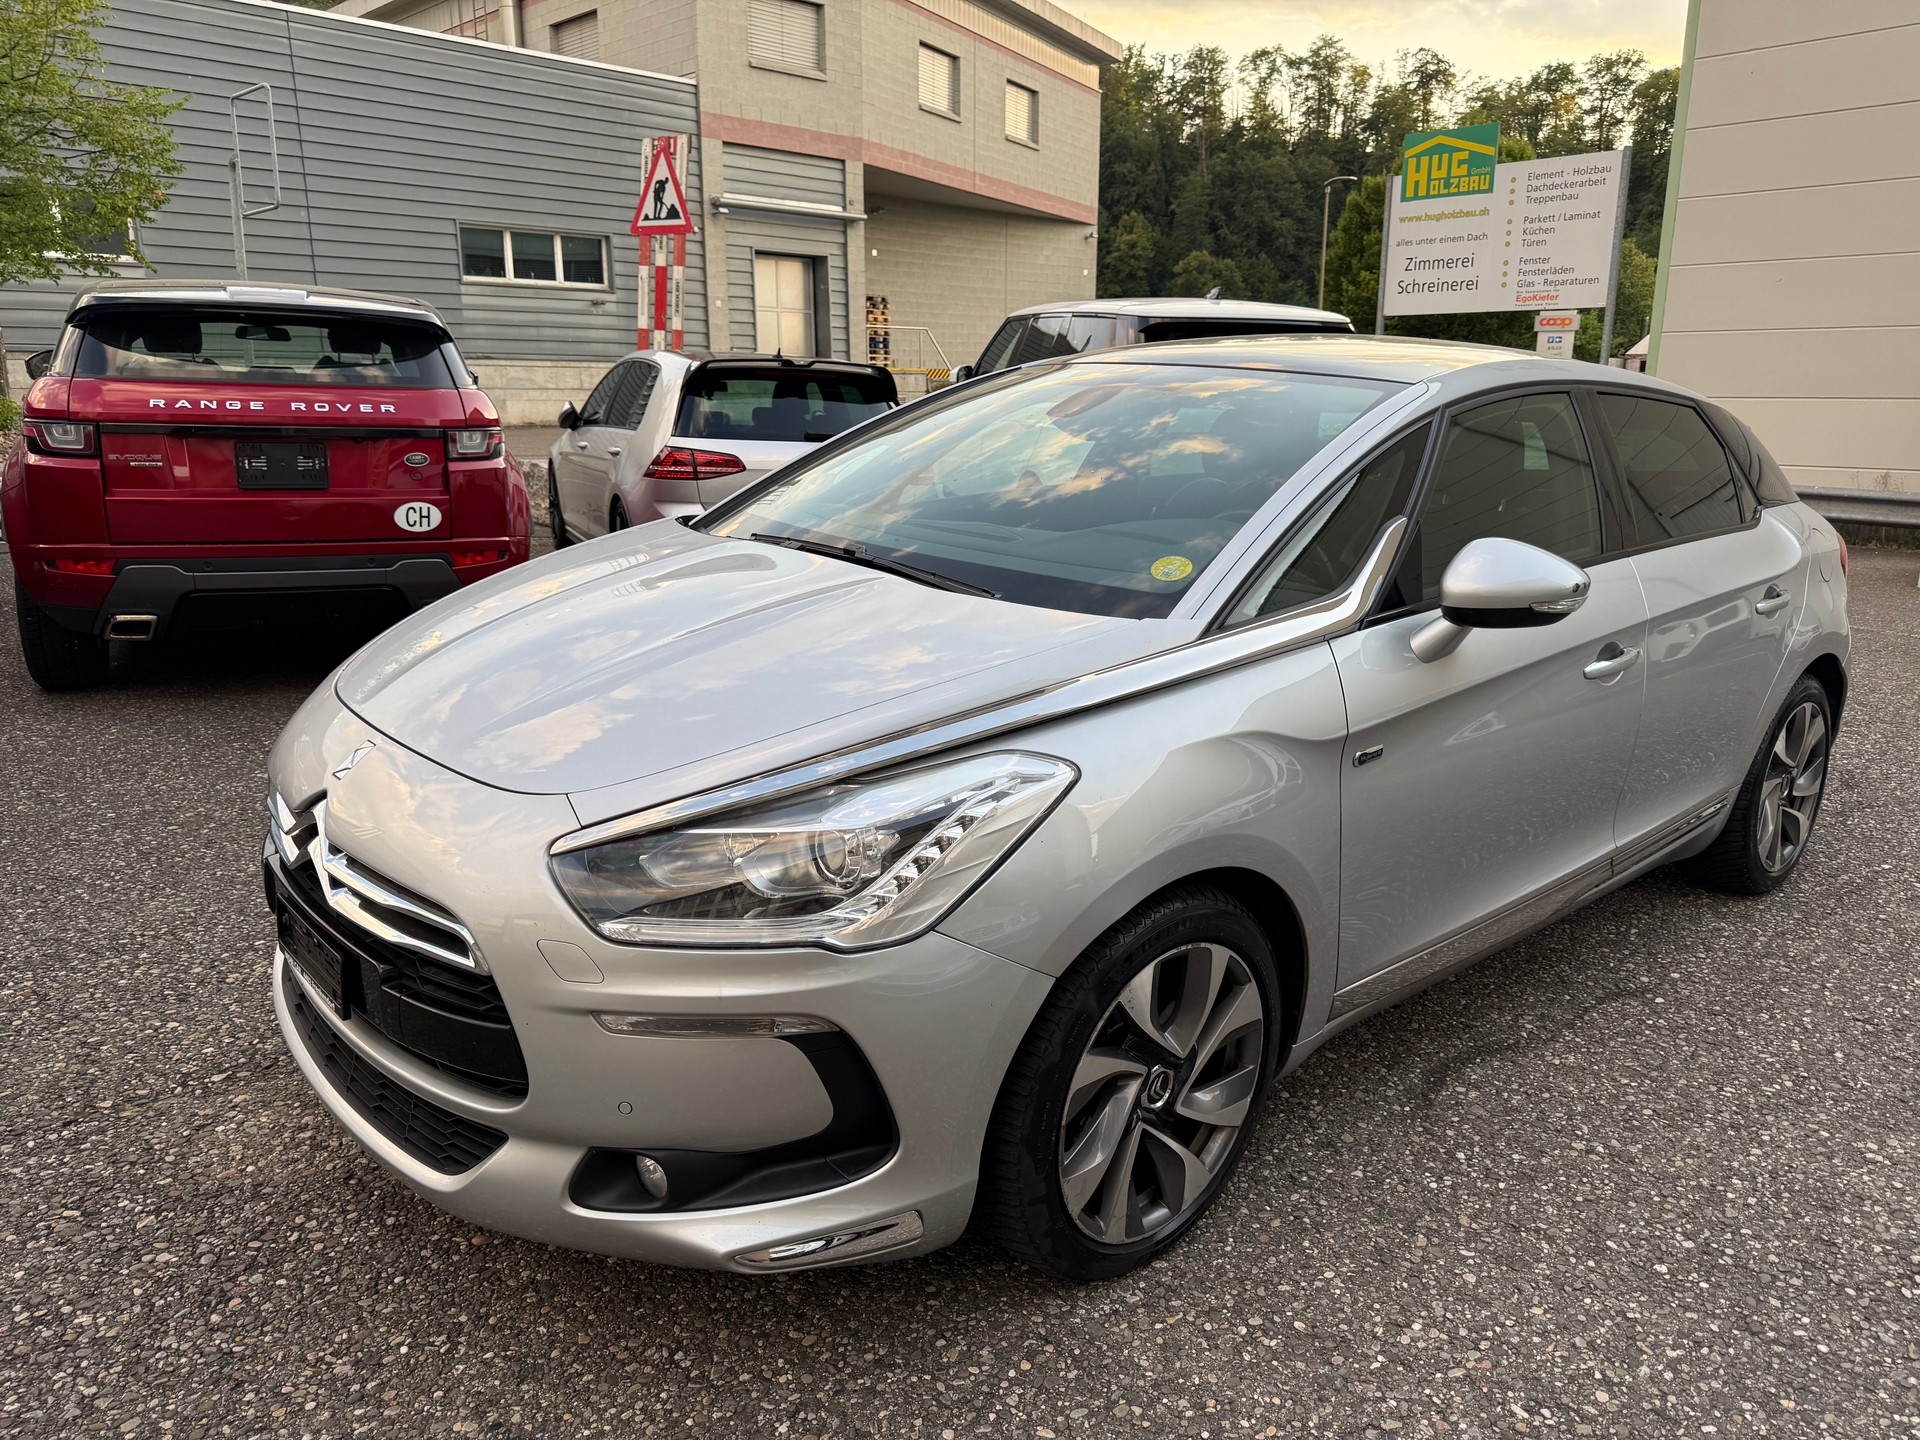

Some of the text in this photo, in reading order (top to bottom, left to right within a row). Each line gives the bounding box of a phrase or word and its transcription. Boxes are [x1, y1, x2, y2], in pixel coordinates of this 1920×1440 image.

[1406, 150, 1491, 198] HUG GmbH
[1527, 170, 1564, 181] Element
[1572, 165, 1612, 177] Holzbau
[1526, 176, 1606, 193] Dachdeckerarbeit
[1526, 192, 1579, 205] Treppenbau
[1399, 207, 1490, 224] www.hugholzbau.ch
[1523, 214, 1556, 225] Parkett
[1563, 210, 1601, 222] Laminat
[1522, 226, 1556, 236] Küchen
[1395, 232, 1488, 247] alles unter einem Dach
[1521, 238, 1547, 248] Türen
[1404, 252, 1475, 272] Zimmerei
[1518, 256, 1551, 266] Fenster
[1517, 265, 1575, 277] Fensterläden
[1397, 275, 1479, 295] Schreinerei
[1516, 278, 1535, 288] Glas
[1542, 277, 1600, 288] Reparaturen
[1515, 293, 1560, 304] EgoKiefer
[1539, 317, 1573, 328] coop
[149, 399, 396, 413] RANGE ROVER
[406, 506, 431, 528] CH
